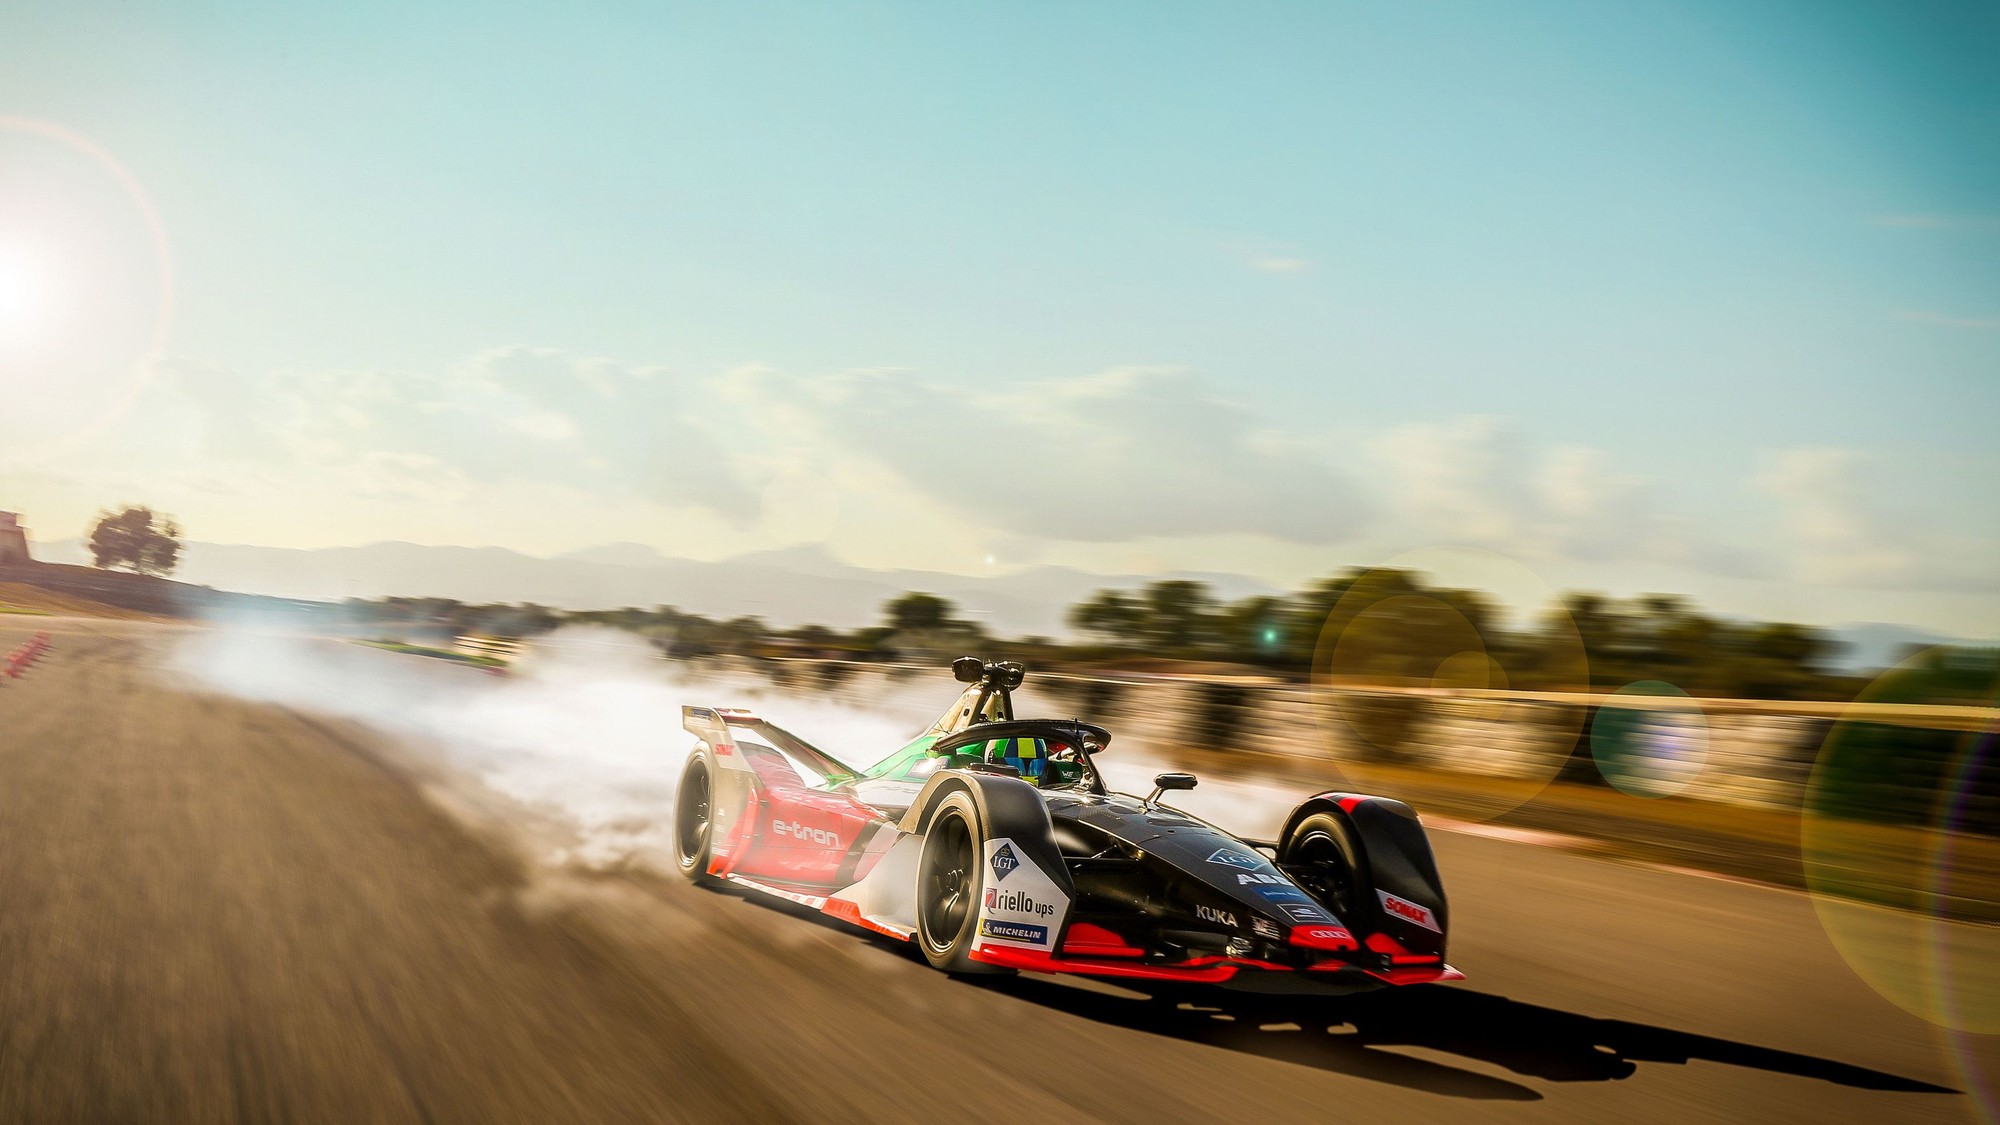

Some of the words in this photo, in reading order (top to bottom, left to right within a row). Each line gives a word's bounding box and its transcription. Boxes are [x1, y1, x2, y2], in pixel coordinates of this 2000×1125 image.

[773, 819, 840, 848] e-tron
[993, 855, 1015, 870] LGT
[998, 889, 1033, 913] riello
[1035, 903, 1055, 918] ups
[1195, 904, 1239, 928] KUKA
[993, 926, 1041, 939] MICHELIN
